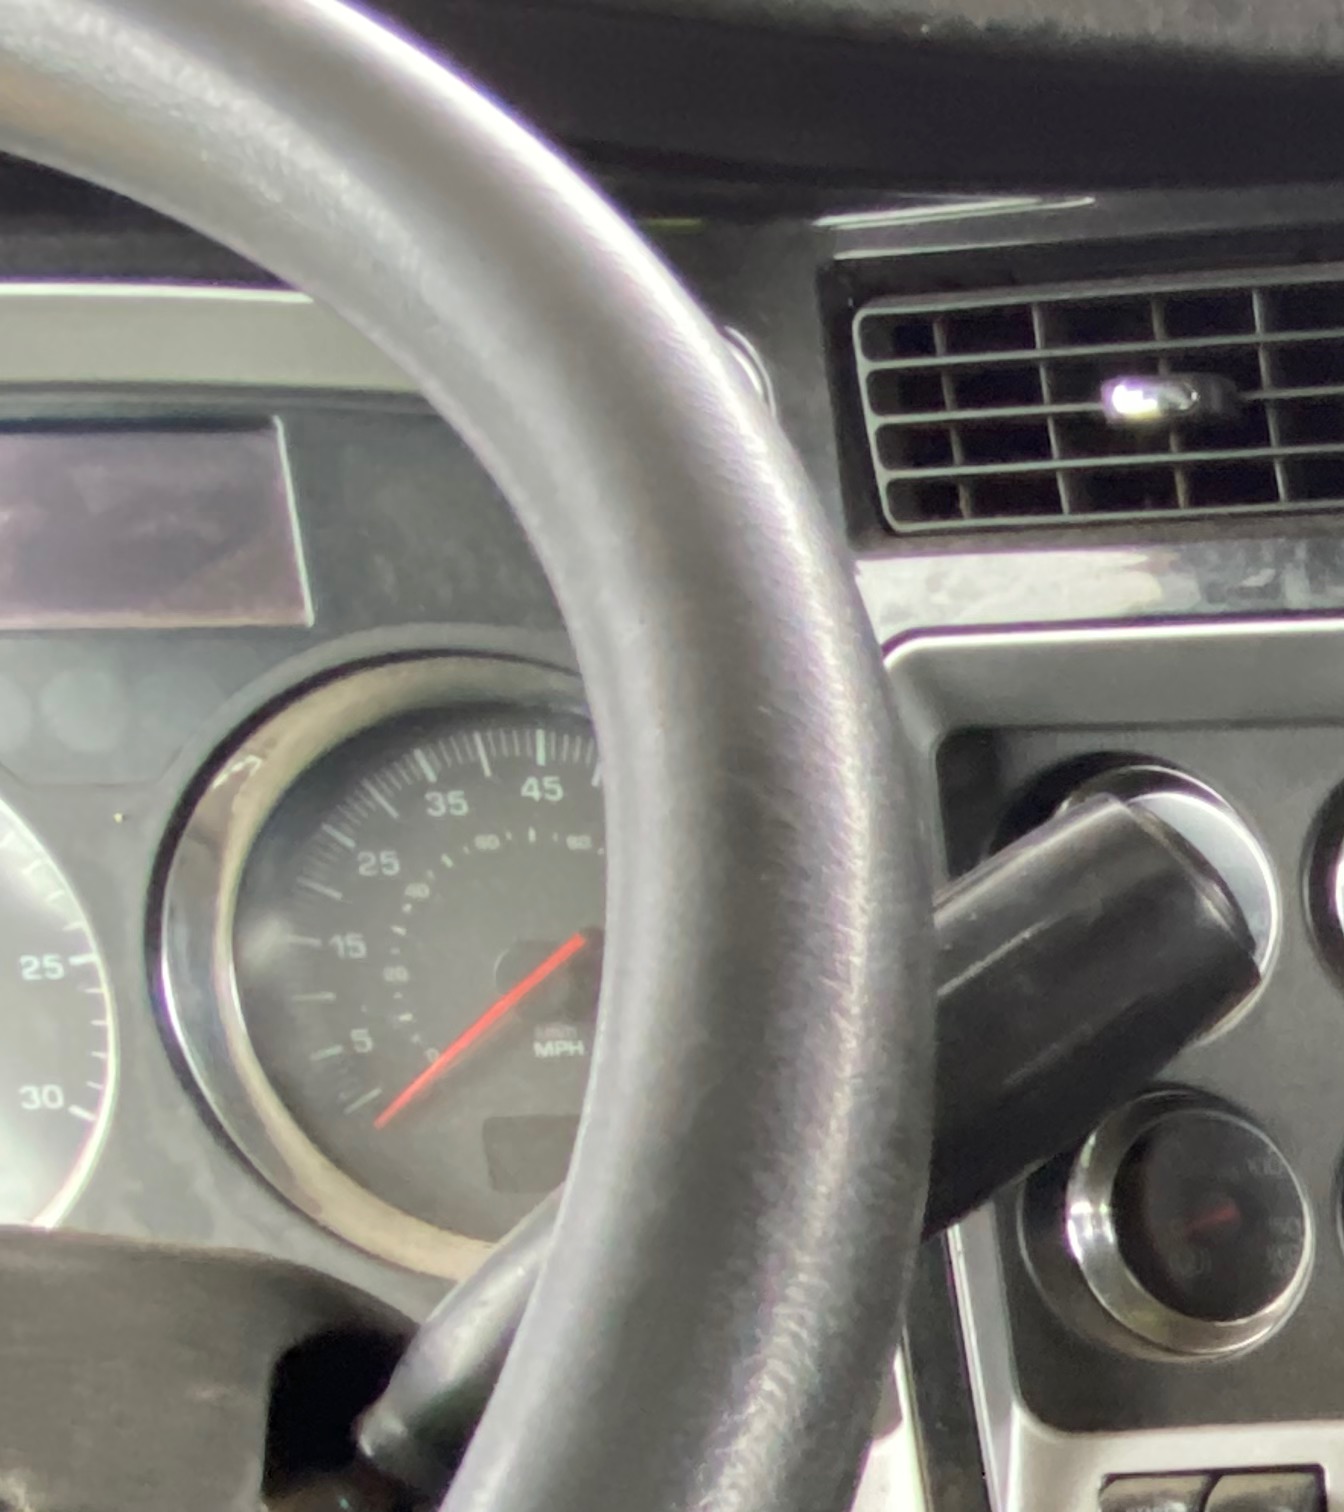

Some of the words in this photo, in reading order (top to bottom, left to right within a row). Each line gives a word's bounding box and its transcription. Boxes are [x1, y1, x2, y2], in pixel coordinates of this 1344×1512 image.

[520, 775, 564, 802] 45
[424, 790, 470, 818] 35
[357, 850, 400, 877] 25
[329, 932, 367, 959] 15
[19, 954, 66, 981] 25
[349, 1028, 373, 1053] 5
[532, 1039, 586, 1059] MPH
[18, 1084, 65, 1110] 30
